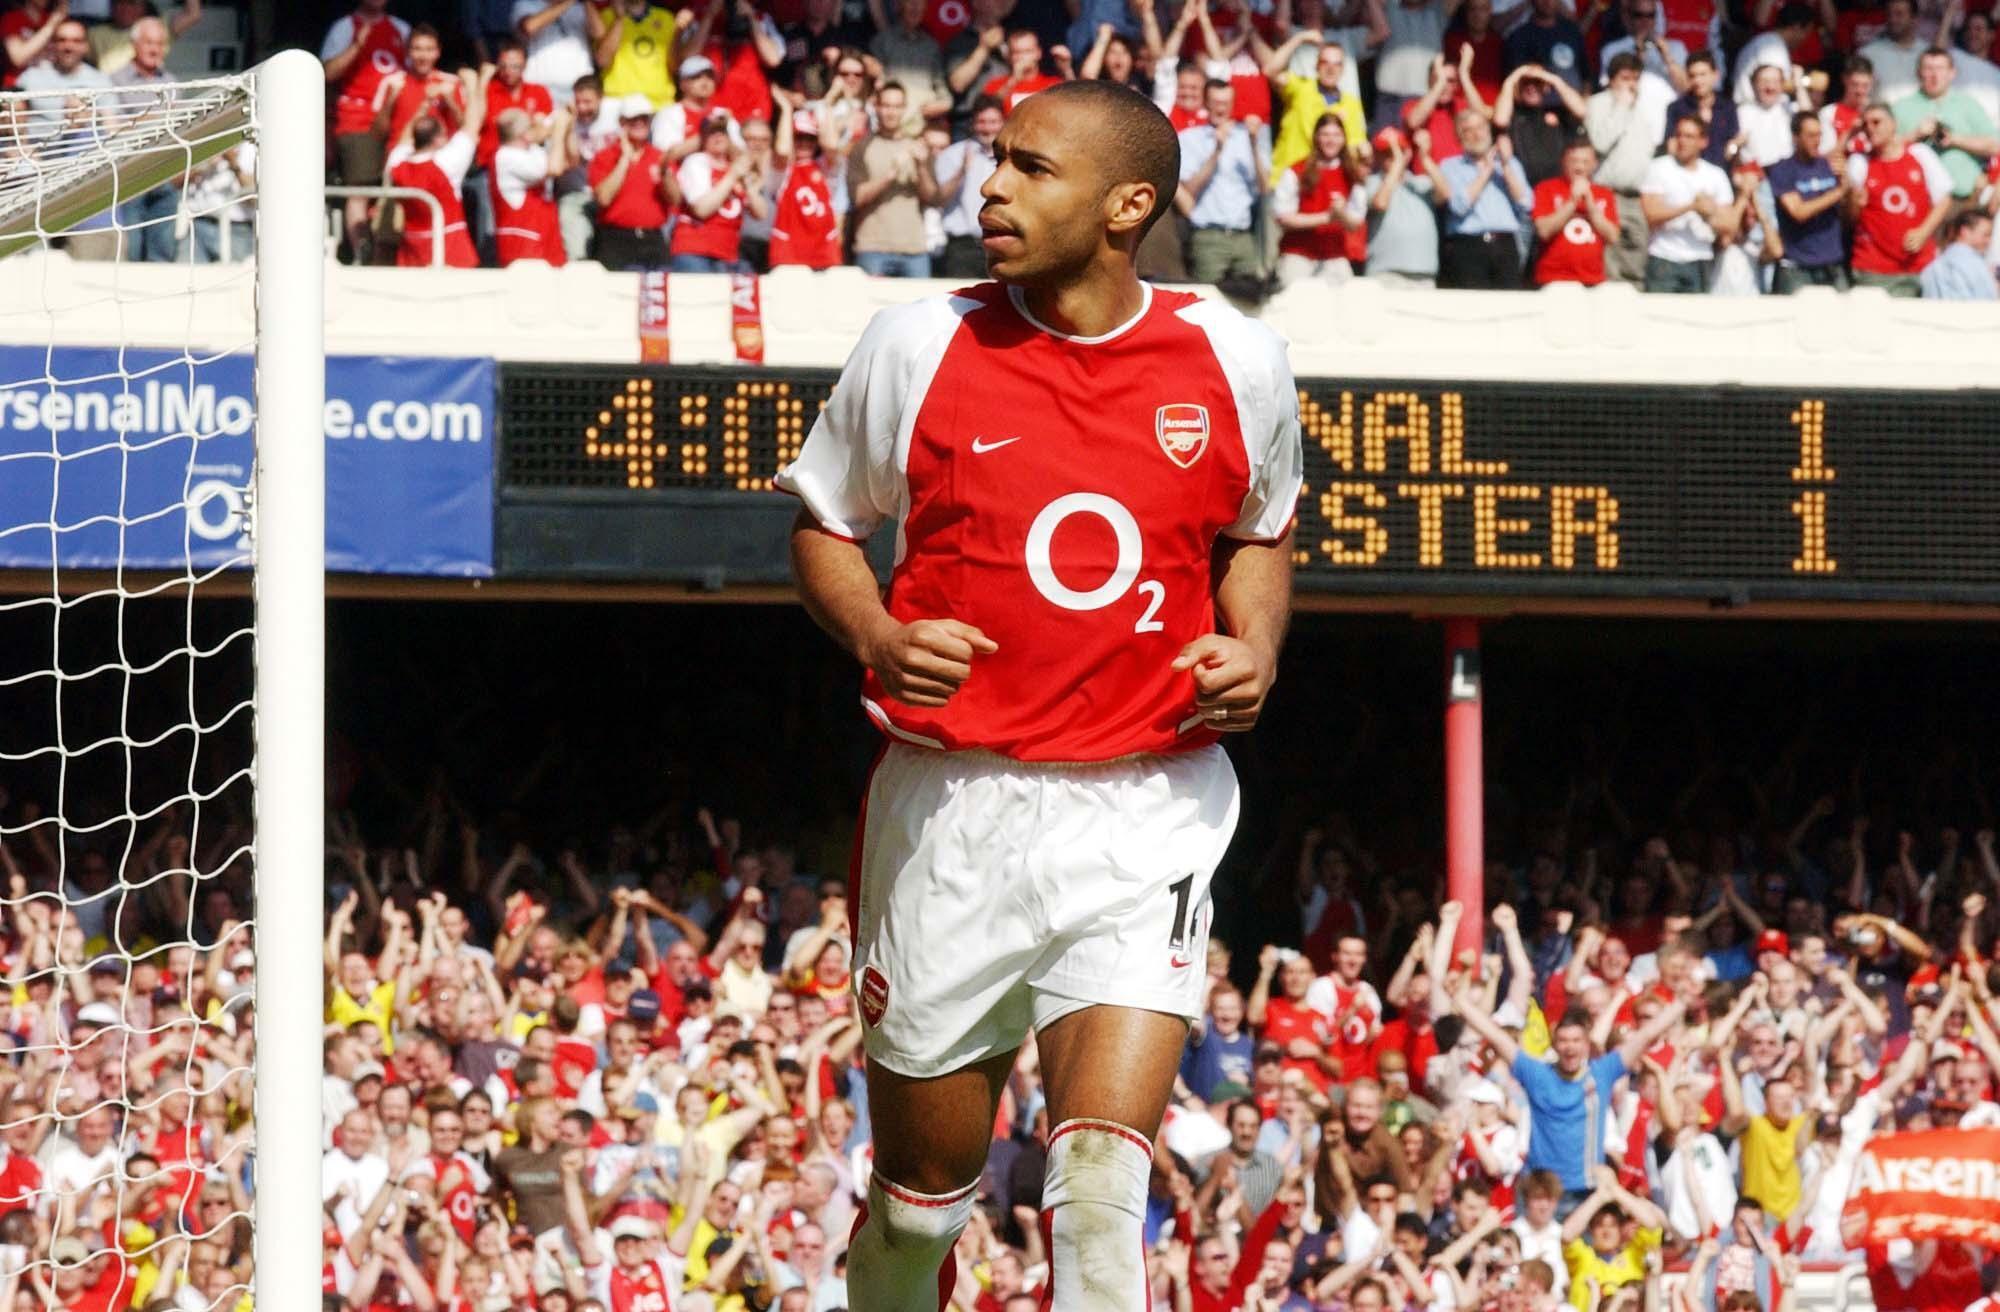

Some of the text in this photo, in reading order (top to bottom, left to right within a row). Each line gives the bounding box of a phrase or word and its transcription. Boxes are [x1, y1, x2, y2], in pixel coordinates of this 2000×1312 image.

[585, 379, 838, 490] 4:0
[1791, 400, 1836, 481] 1
[1025, 492, 1166, 634] O2
[1292, 481, 1838, 572] STER 1
[1452, 653, 1478, 698] L
[1847, 1149, 2000, 1201] Arsen
